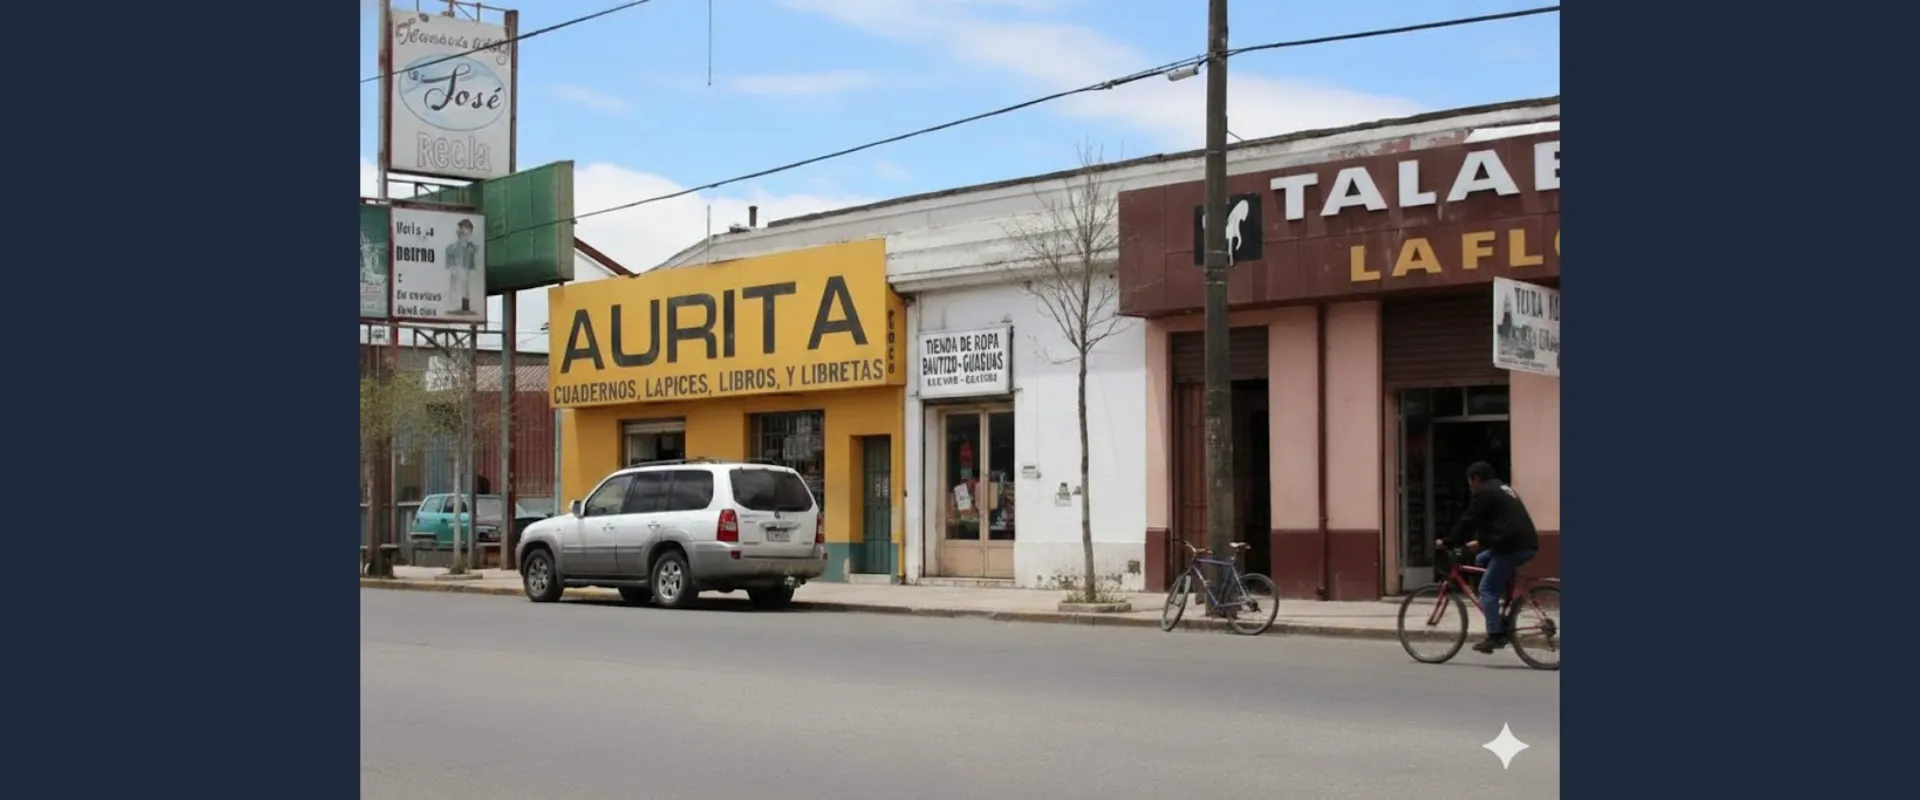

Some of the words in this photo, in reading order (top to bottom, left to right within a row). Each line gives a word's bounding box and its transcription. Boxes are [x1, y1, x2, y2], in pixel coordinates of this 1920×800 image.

[421, 62, 503, 112] José
[1350, 238, 1443, 283] LA
[1462, 228, 1561, 270] FL
[559, 274, 868, 374] AURITA
[926, 336, 958, 355] TIENDA
[960, 335, 972, 352] DE
[974, 332, 1000, 351] ROPA
[553, 379, 641, 405] CUADERNOS,
[646, 373, 713, 399] LAPICES,
[719, 365, 780, 392] LIBROS,
[787, 365, 796, 387] Y
[801, 357, 885, 386] LIBRETAS
